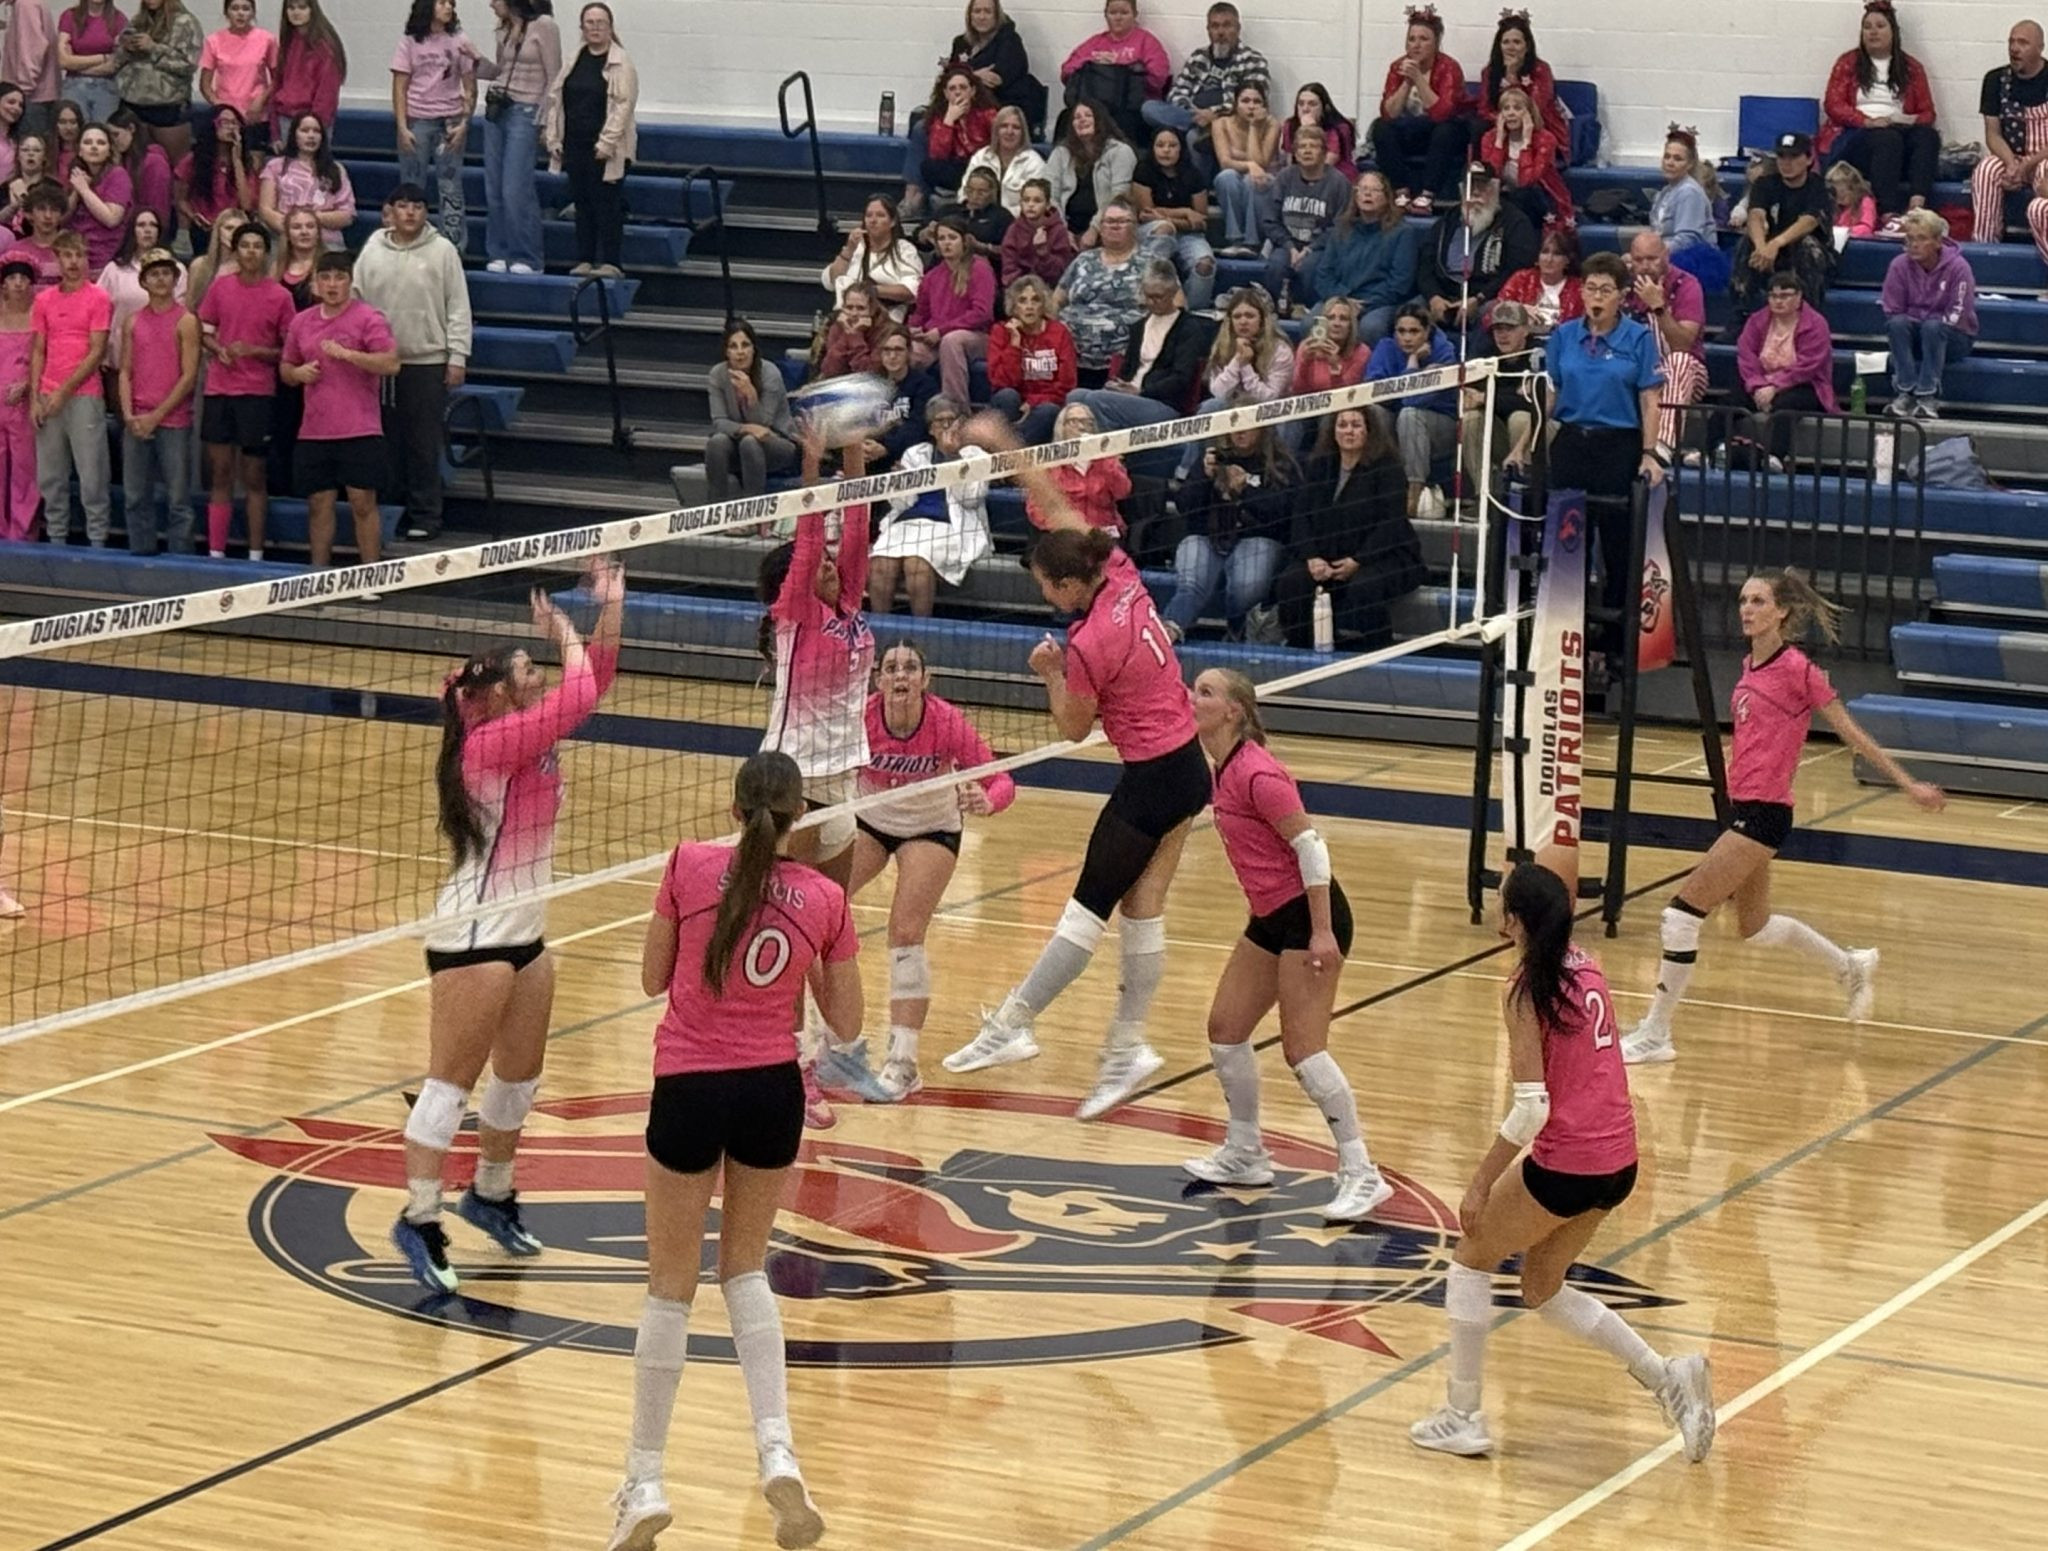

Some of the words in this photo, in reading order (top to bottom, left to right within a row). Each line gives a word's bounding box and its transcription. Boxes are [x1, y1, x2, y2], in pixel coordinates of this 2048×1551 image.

[1372, 377, 1406, 398] DOUGLAS
[1408, 370, 1442, 392] PATRIOTS
[1255, 400, 1293, 423] DOUGLAS
[1295, 393, 1332, 416] PATRIOTS
[1129, 422, 1169, 446] DOUGLAS
[1171, 416, 1212, 441] PATRIOTS
[1036, 441, 1081, 464] PATRIOTS
[837, 476, 887, 502] DOUGLAS
[888, 468, 937, 493] PATRIOTS
[668, 506, 721, 534] DOUGLAS
[725, 496, 778, 524] PATRIOTS
[479, 538, 540, 569] DOUGLAS
[542, 527, 602, 557] PATRIOTS
[267, 573, 335, 606] DOUGLAS
[338, 562, 407, 594] PATRIOTS
[30, 609, 105, 645] DOUGLAS
[108, 599, 187, 633] PATRIOTS
[1540, 689, 1558, 796] DOUGLAS
[1553, 630, 1583, 847] PATRIOTS
[871, 753, 940, 773] ATRIOTS
[743, 926, 791, 988] 0
[1584, 988, 1613, 1052] 2
